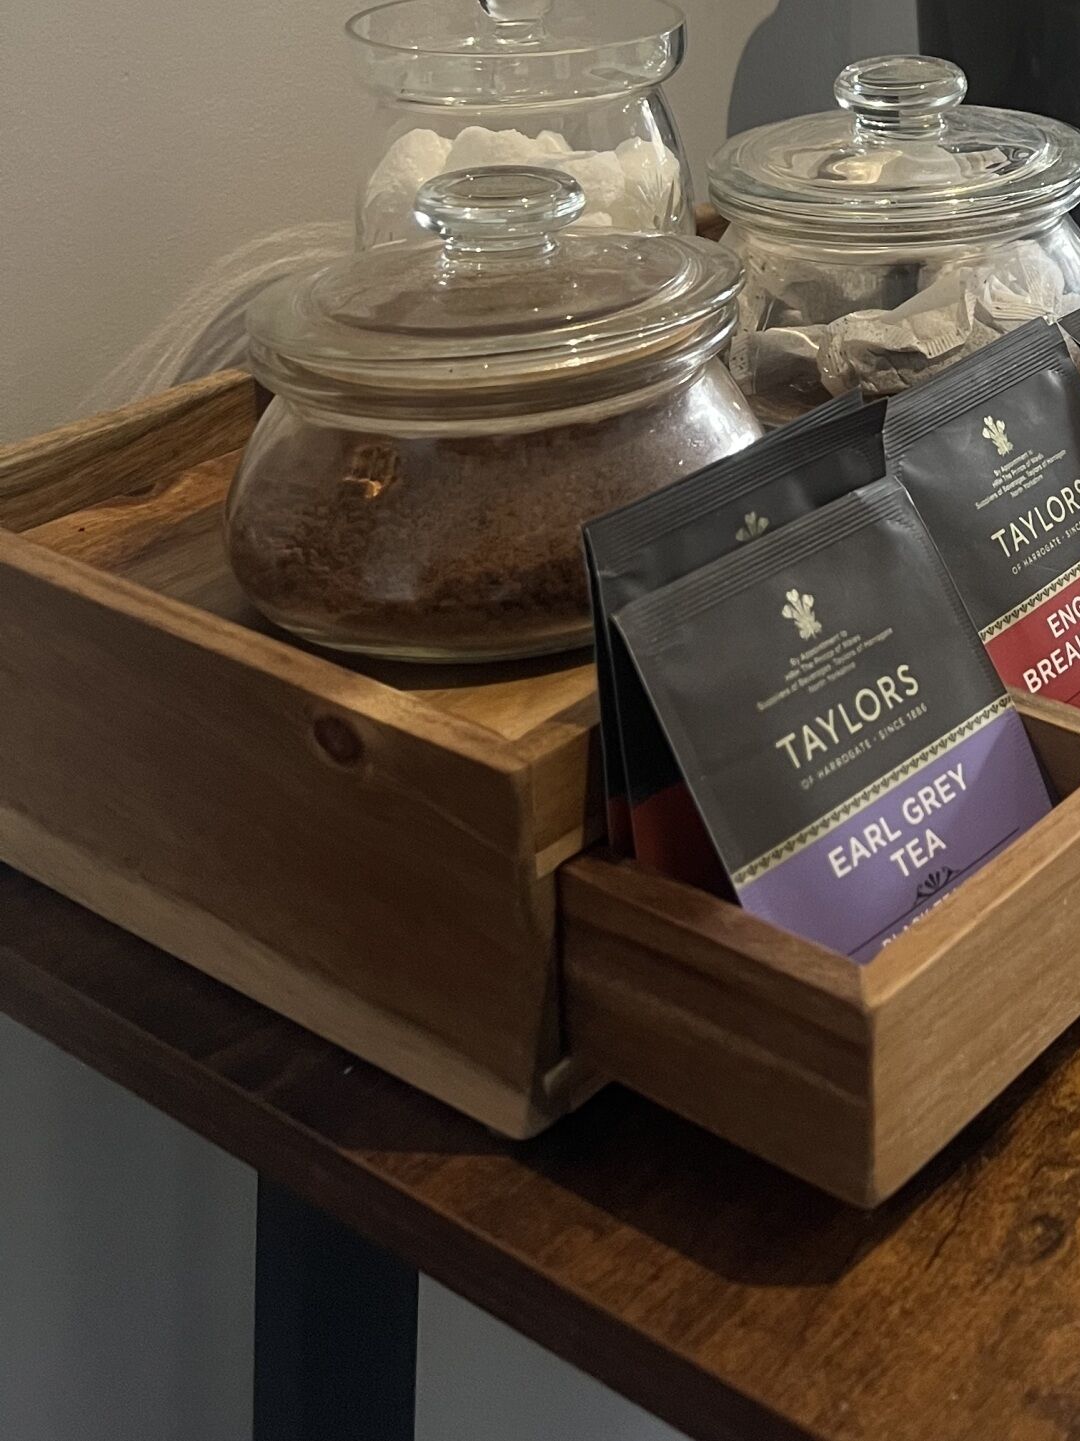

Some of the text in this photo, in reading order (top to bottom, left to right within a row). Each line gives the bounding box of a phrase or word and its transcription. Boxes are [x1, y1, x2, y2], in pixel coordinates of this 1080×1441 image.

[1011, 565, 1022, 575] OF
[1023, 536, 1062, 567] HARROGATE
[775, 664, 919, 769] TAYLORS
[801, 775, 814, 790] OF
[818, 738, 872, 779] HARROGATE
[878, 716, 906, 740] SINCE
[827, 762, 967, 879] EARL GREY
[889, 828, 947, 877] TEA
